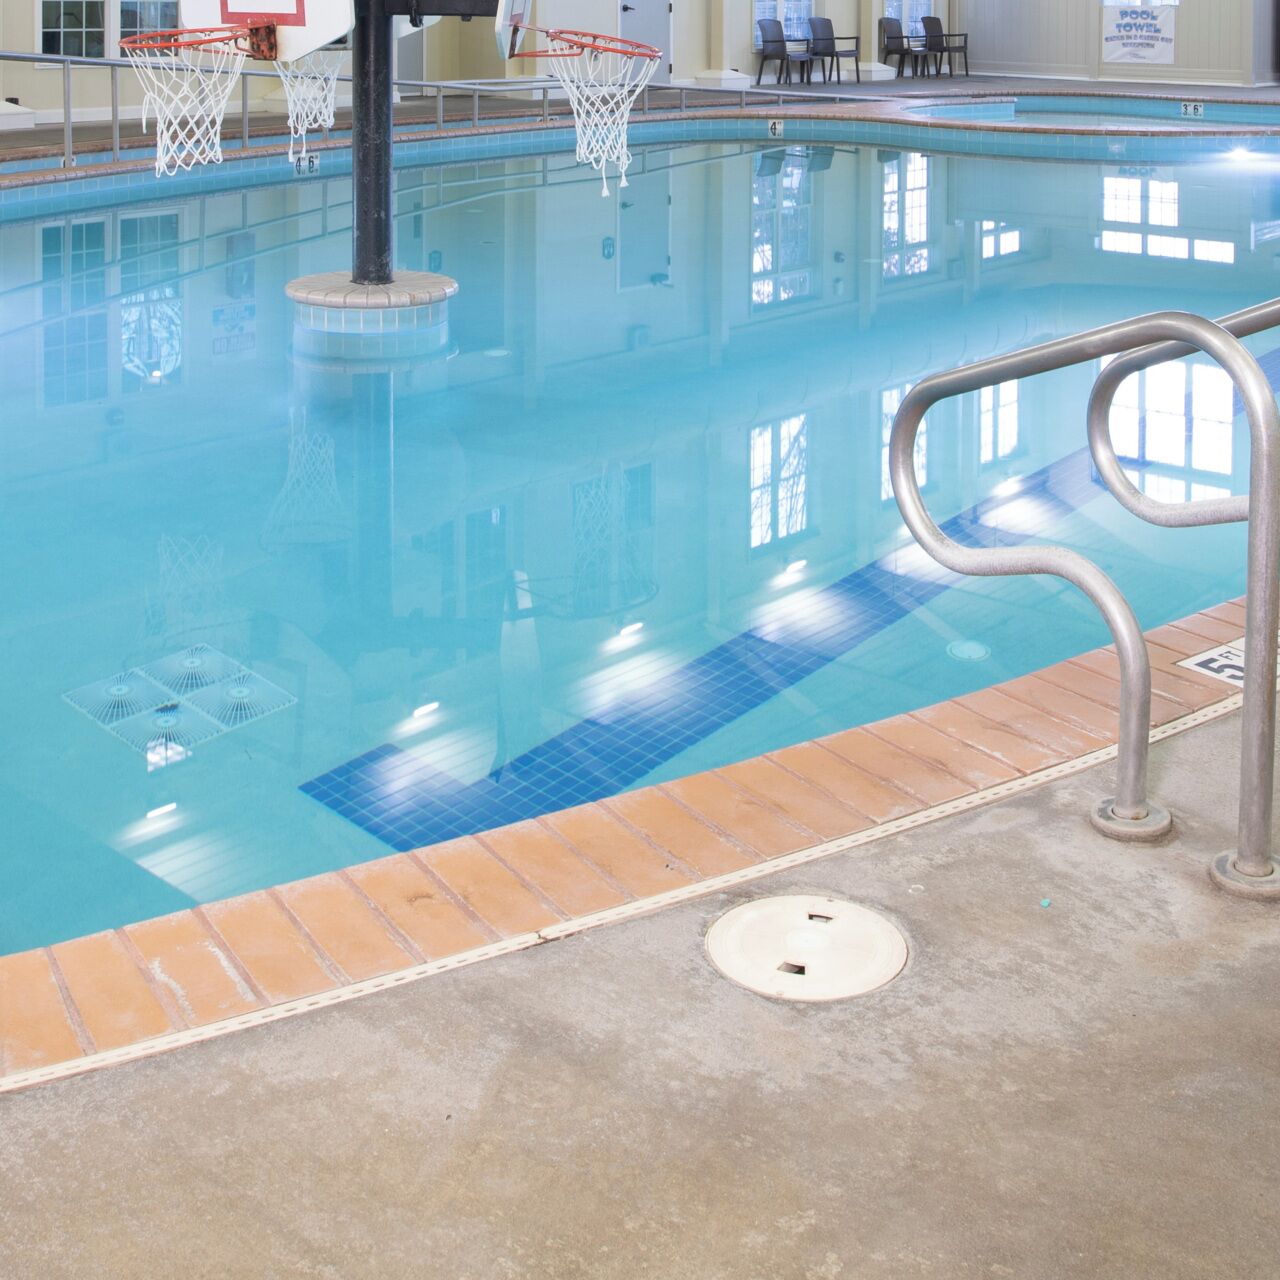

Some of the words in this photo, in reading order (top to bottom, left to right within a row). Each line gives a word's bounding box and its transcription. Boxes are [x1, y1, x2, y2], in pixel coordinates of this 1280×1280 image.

[1120, 10, 1158, 21] POOL
[1115, 22, 1162, 33] TOWEL
[1218, 649, 1242, 662] FT
[1194, 656, 1246, 681] 5
